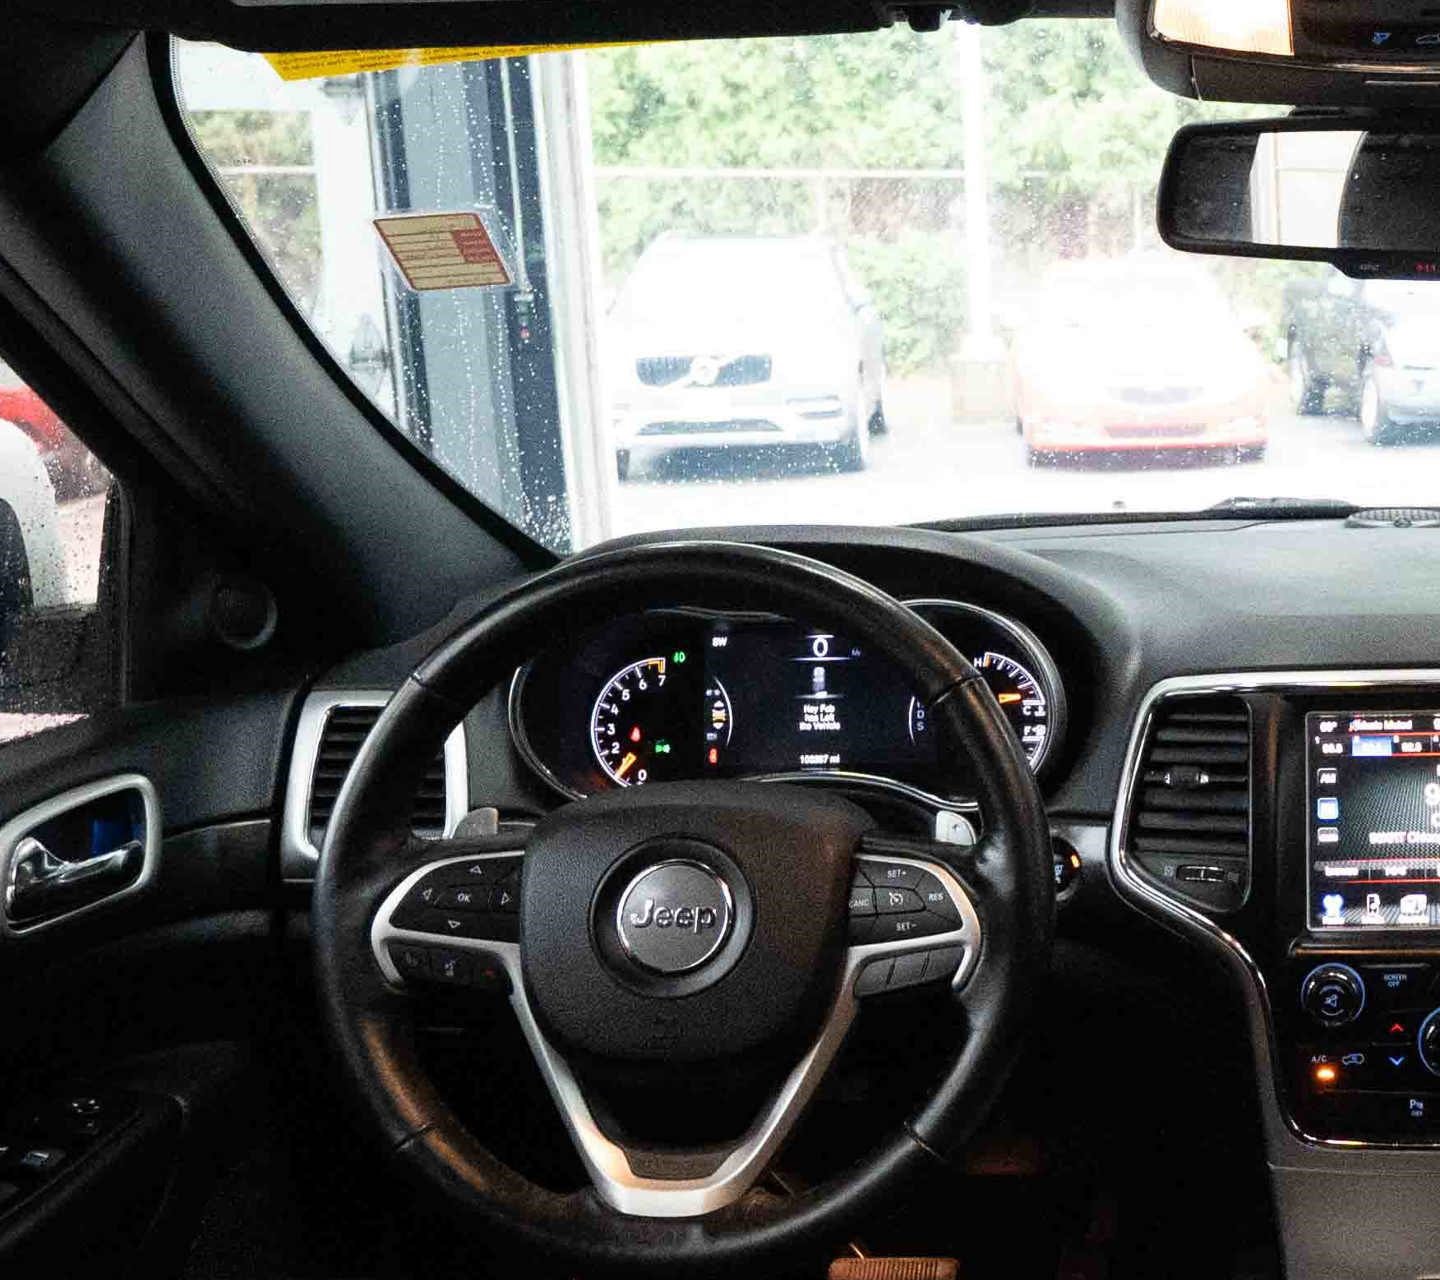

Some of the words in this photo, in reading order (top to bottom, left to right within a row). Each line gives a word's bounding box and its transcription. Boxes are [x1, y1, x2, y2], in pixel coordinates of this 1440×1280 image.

[712, 637, 727, 647] SW
[813, 638, 828, 657] 0
[639, 680, 647, 690] 6
[658, 675, 666, 687] 7
[622, 690, 630, 700] 5
[611, 705, 619, 715] 4
[608, 724, 616, 735] 3
[611, 742, 620, 754] 2
[638, 769, 647, 781] 0
[457, 892, 471, 903] OK
[928, 893, 944, 902] RES
[630, 899, 717, 933] Jeep
